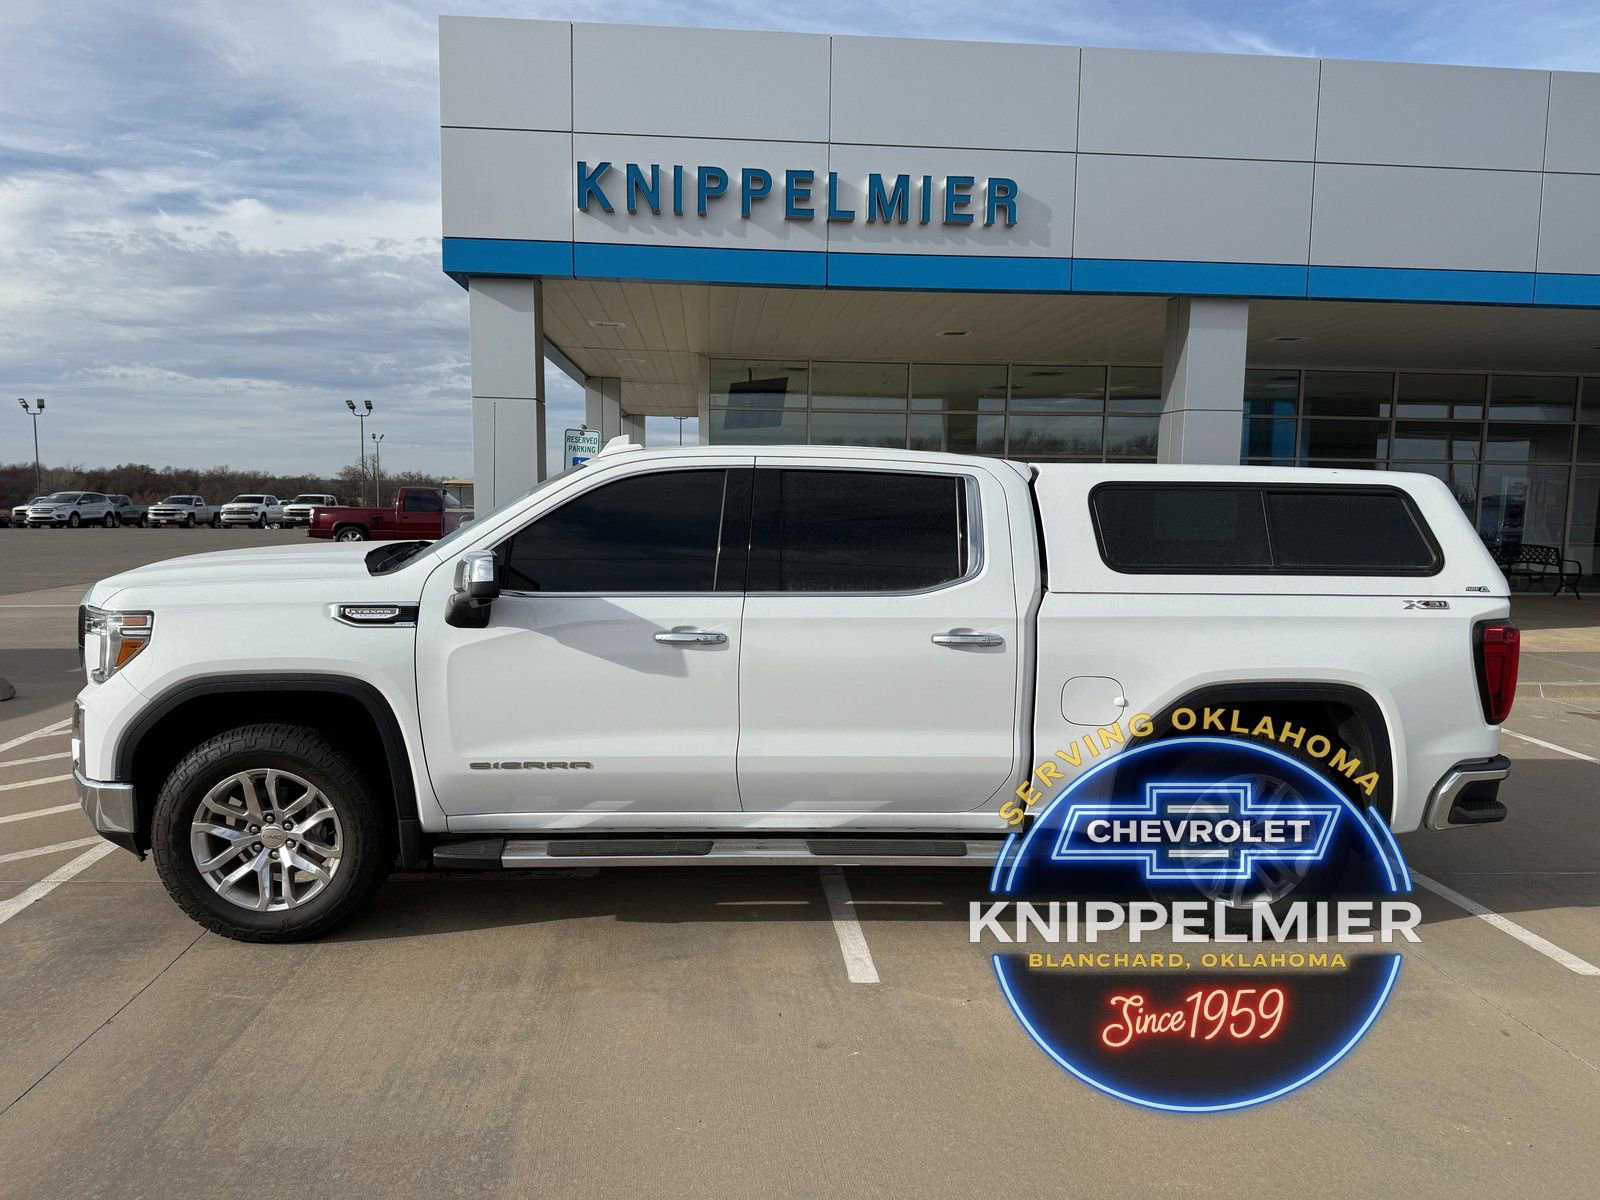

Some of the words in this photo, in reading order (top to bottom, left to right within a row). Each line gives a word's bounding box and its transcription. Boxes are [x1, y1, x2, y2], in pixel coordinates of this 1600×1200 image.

[576, 161, 1018, 227] KNIPPELMIER
[566, 435, 598, 444] RESERVED
[568, 445, 596, 453] PARKING
[469, 762, 593, 770] SIERRA
